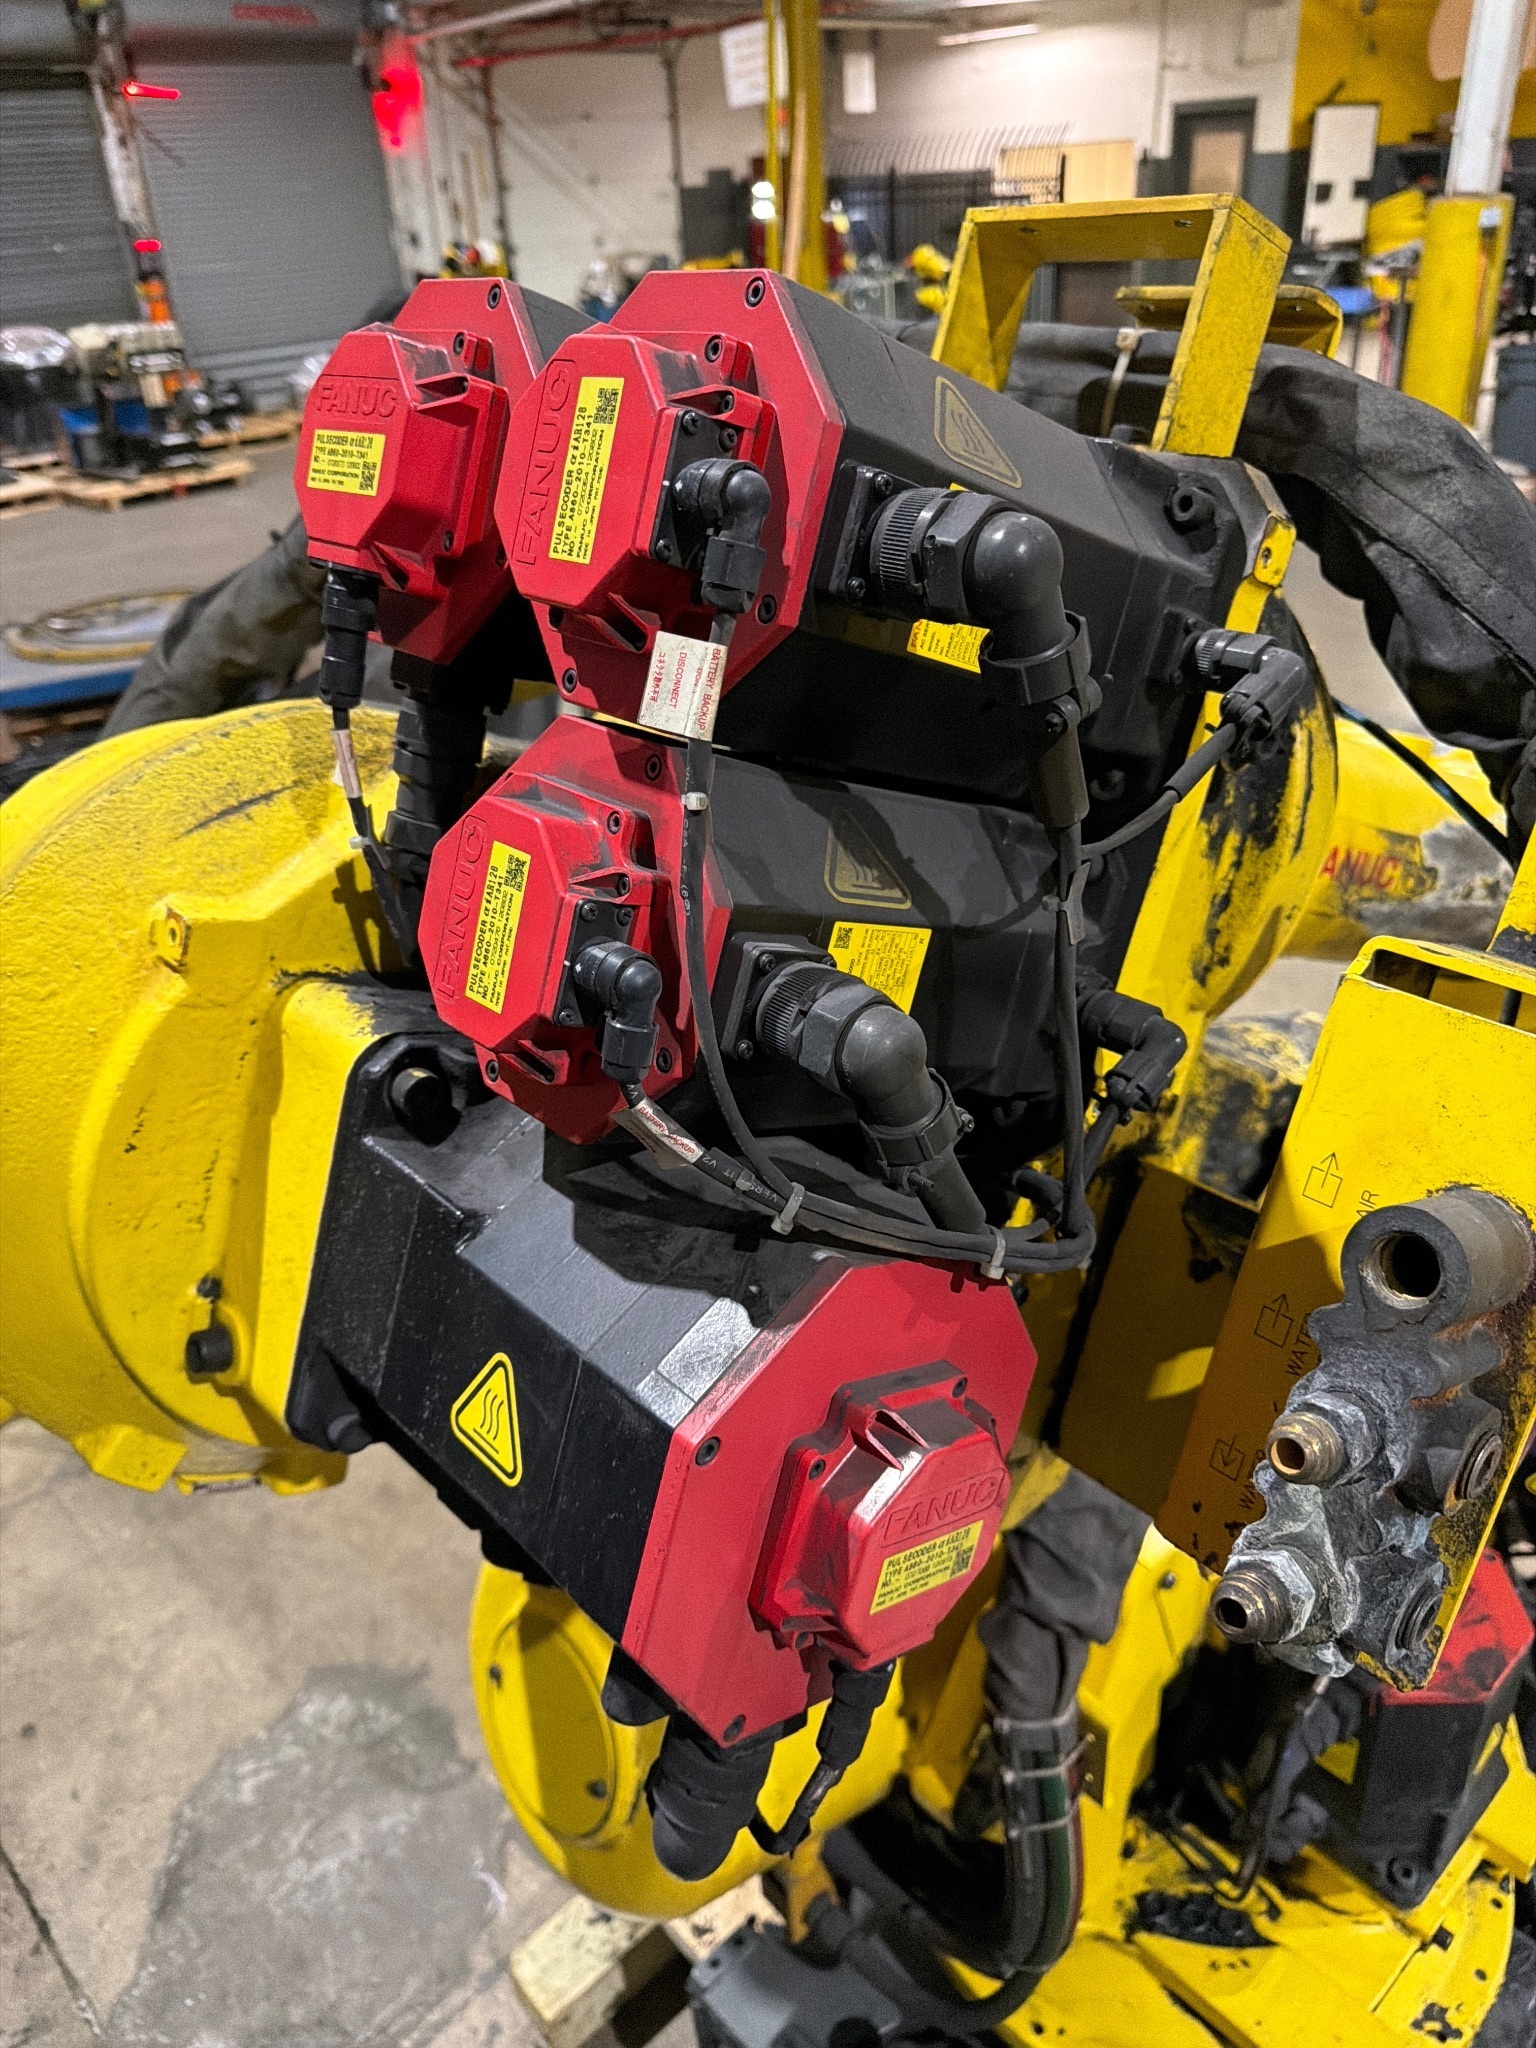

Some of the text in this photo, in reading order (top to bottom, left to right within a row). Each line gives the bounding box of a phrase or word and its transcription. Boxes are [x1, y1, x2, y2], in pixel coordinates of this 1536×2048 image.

[316, 382, 397, 418] FANUC
[517, 367, 573, 566] FANUC
[561, 415, 593, 555] TYPE A860-2010-T341
[576, 429, 604, 558] FANUC CORPORATION
[552, 470, 574, 554] PULSECODER
[911, 620, 923, 647] FAN
[669, 652, 688, 709] DISCONNECT
[698, 648, 721, 731] BATTERY BACKUP
[1320, 845, 1399, 890] ANUC
[438, 823, 485, 999] FANUC
[476, 876, 504, 995] TYPE A860-2010-T341
[469, 920, 487, 993] PULSECODER
[489, 893, 514, 1003] FANUC CORPORATION
[640, 1106, 668, 1133] BATTERY
[1356, 1189, 1380, 1218] AIR
[883, 1476, 997, 1542] FANUC
[884, 1566, 903, 1581] TYPE
[886, 1542, 937, 1570] PULSECODER
